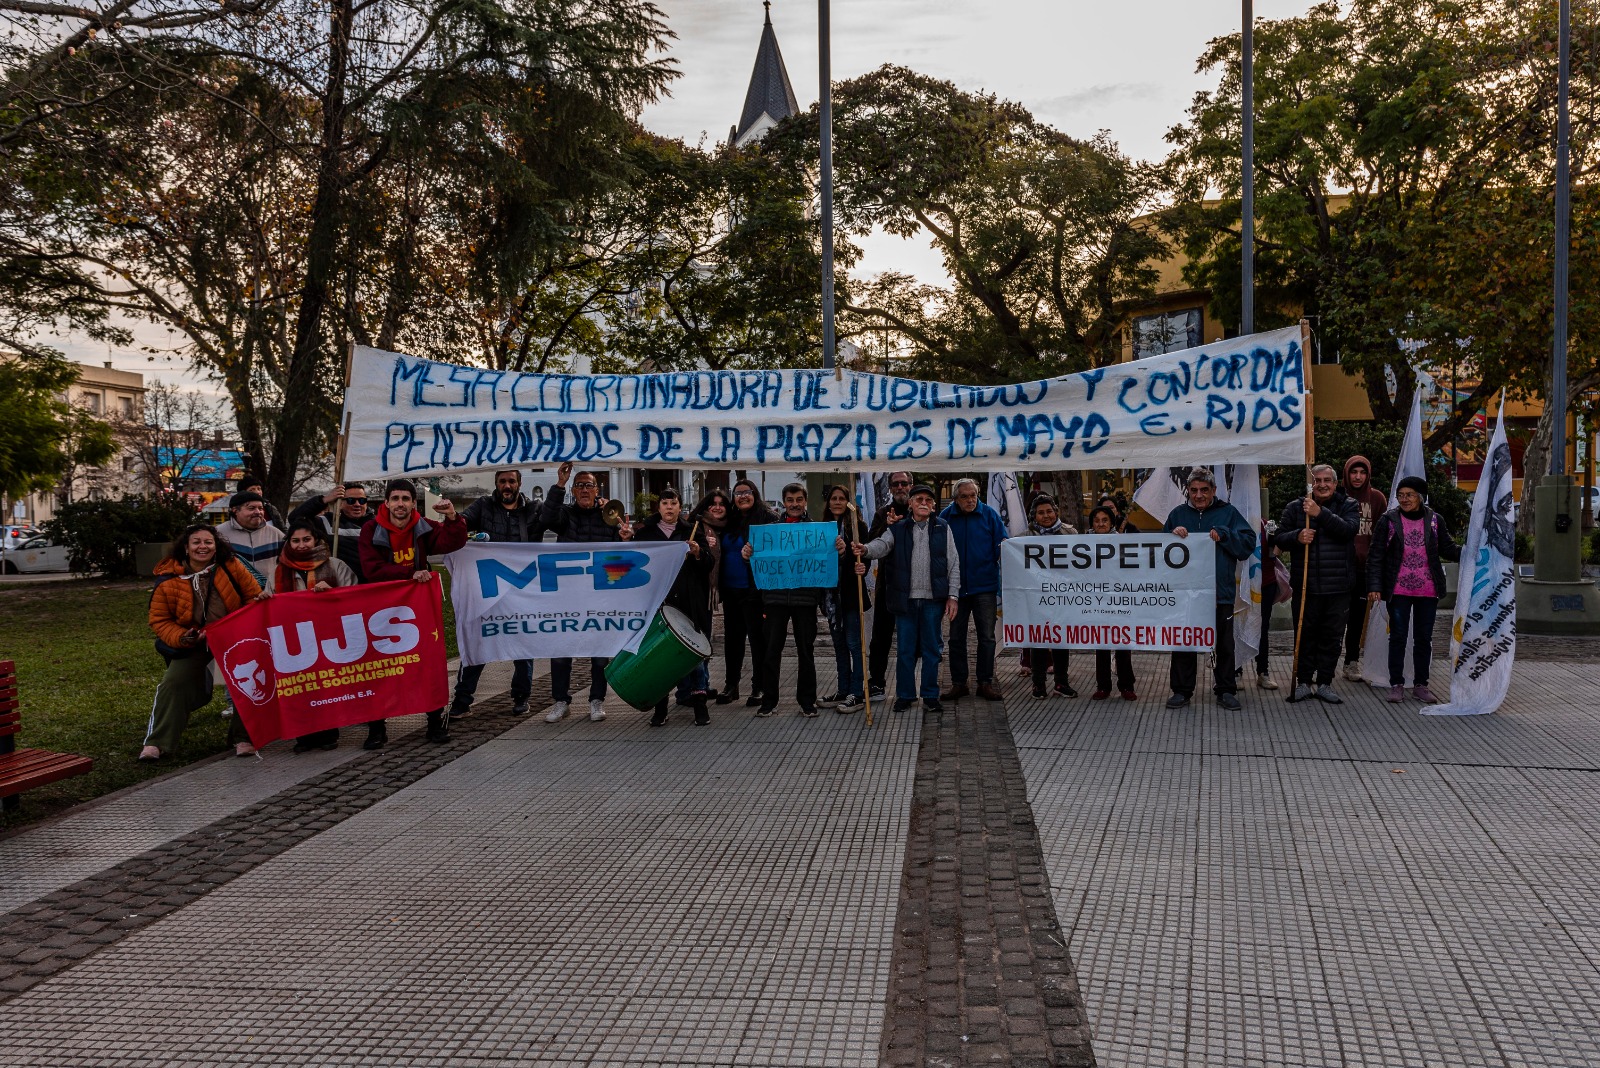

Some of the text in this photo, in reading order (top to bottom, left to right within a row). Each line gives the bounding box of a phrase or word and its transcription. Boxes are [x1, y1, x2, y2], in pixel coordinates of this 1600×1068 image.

[390, 356, 506, 411] MESA
[511, 369, 782, 413] COORDINADORA
[793, 369, 834, 411] DE
[1079, 368, 1106, 401] Y
[1117, 341, 1304, 413] CONCORDIA
[1140, 393, 1302, 437] E. RIOS
[381, 410, 1111, 473] PENSIONADOS DE LA PLAZA 25 DE MAYO
[752, 528, 828, 553] LA PATRIA
[393, 547, 415, 564] UJ
[787, 559, 827, 575] VENDE
[1024, 542, 1190, 570] RESPETO
[476, 550, 652, 599] MFB
[1041, 582, 1173, 593] ENGANCHE SALARIAL
[1039, 595, 1176, 607] ACTIVOS Y JUBILADOS
[480, 609, 648, 623] Movimiento Federal
[481, 617, 646, 638] BELGRANO
[266, 605, 420, 674] UJS
[1004, 621, 1215, 647] NO MÁS MONTOS EN NEGRO
[276, 653, 421, 689] UNIÓN DE JUVENTUDES
[277, 666, 405, 699] POR EL SOCIALISMO
[310, 689, 376, 707] Concordia E.R.
